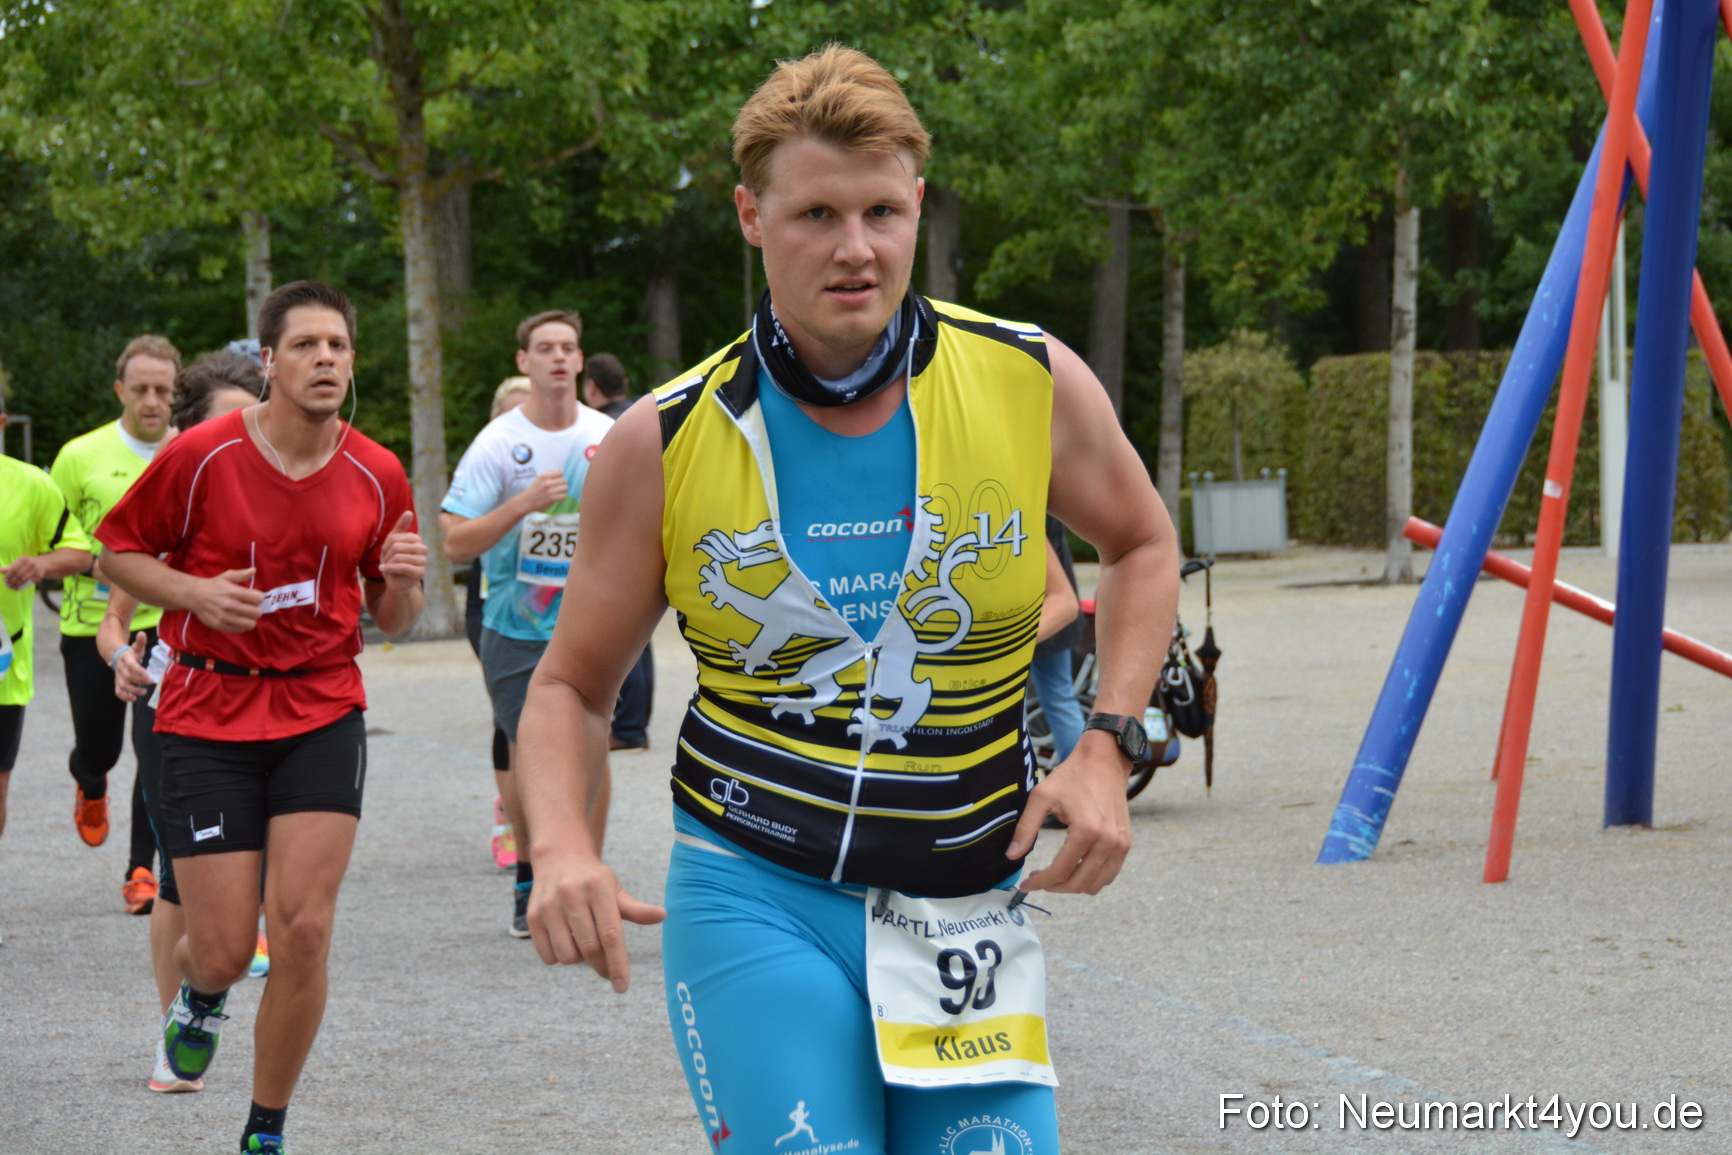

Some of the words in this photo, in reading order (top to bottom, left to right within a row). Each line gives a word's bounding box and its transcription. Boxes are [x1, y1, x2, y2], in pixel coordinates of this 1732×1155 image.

[807, 518, 903, 537] cocoon
[529, 530, 577, 558] 235
[829, 571, 902, 596] MARA
[833, 600, 894, 622] ENS
[878, 723, 943, 736] TRIATHLON
[945, 716, 995, 736] INGOLSTADT
[903, 760, 943, 773] Run
[725, 811, 797, 844] PERSONALTRAINING
[728, 804, 771, 827] GERHARD
[771, 820, 799, 836] BUDY
[937, 909, 1009, 937] Neumarkt
[936, 939, 1003, 1016] 93
[676, 981, 720, 1129] cocoon
[934, 1031, 1012, 1062] Klaus
[939, 1126, 957, 1148] LLC
[957, 1114, 1033, 1147] MARATHON
